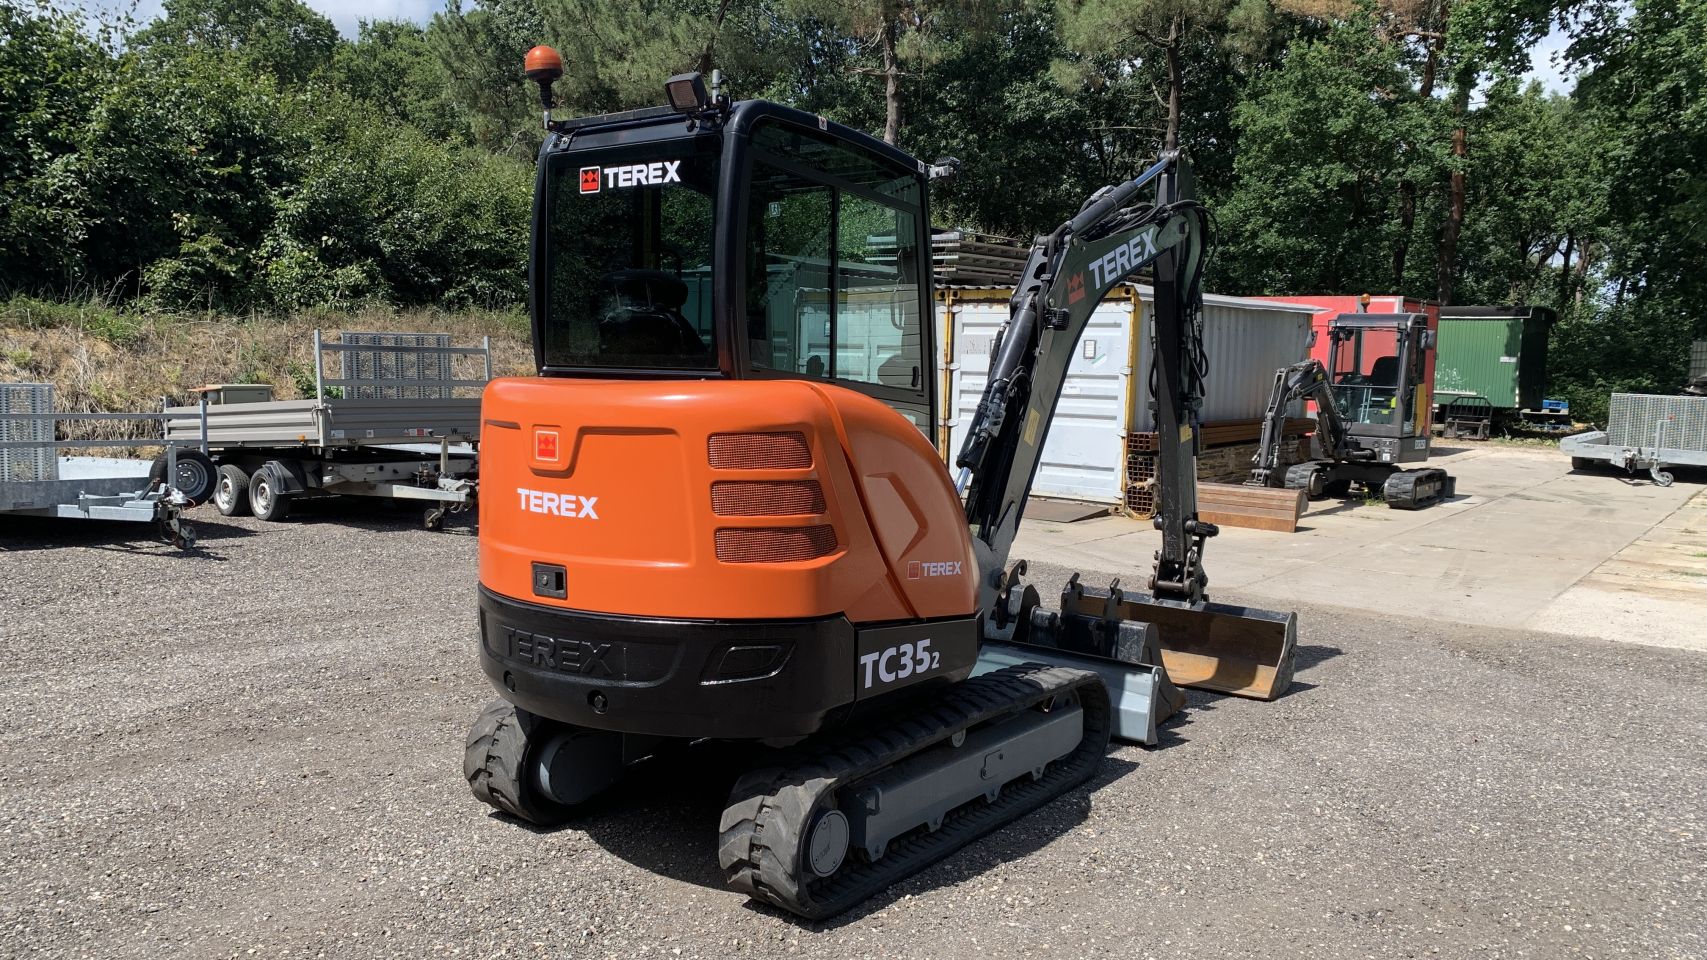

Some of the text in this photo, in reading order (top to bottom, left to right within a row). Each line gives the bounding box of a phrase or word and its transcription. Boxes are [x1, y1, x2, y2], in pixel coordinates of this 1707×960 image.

[603, 160, 681, 188] TEREX
[1088, 228, 1157, 289] TEREX
[517, 488, 599, 519] TEREX
[922, 561, 962, 577] TEREX
[499, 624, 612, 674] TEREX
